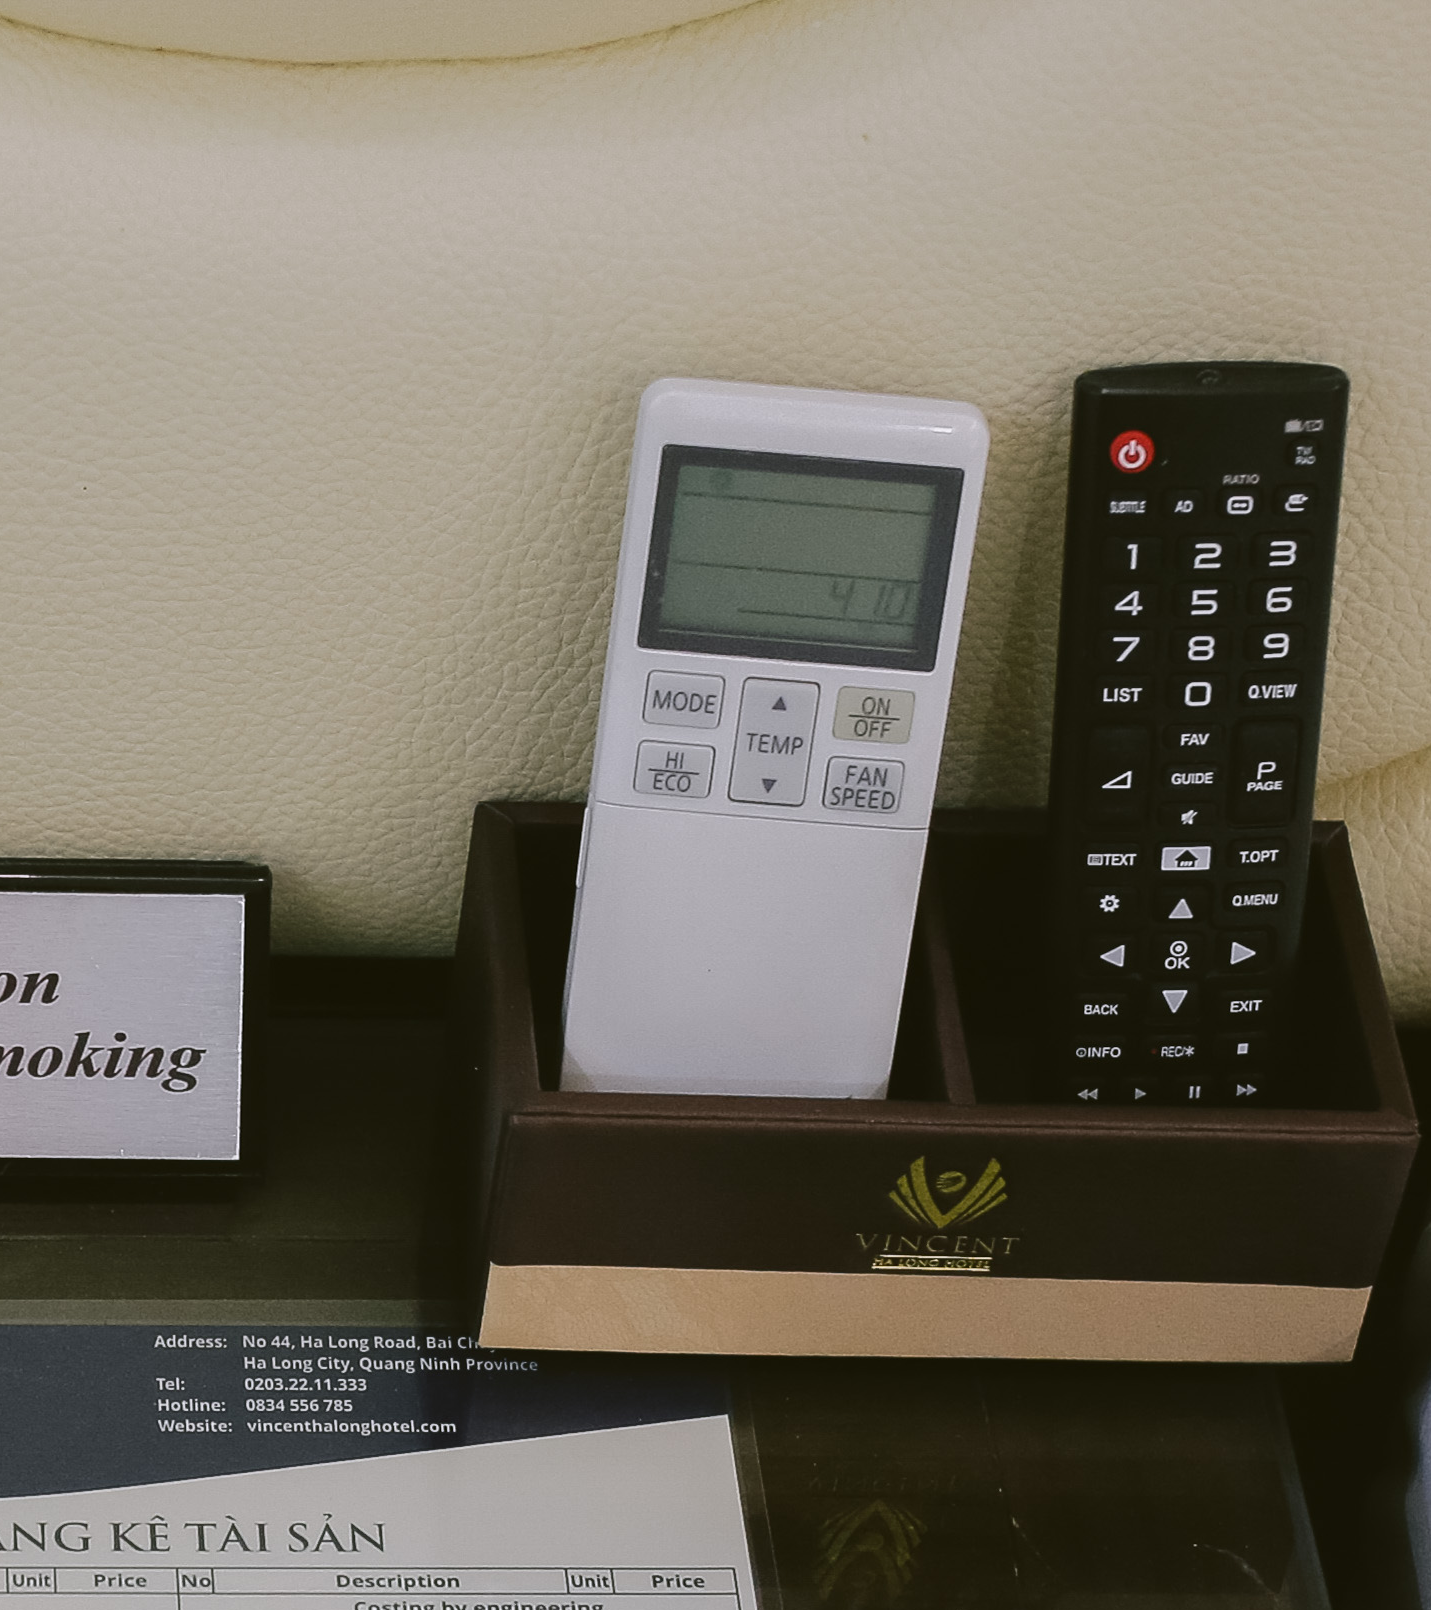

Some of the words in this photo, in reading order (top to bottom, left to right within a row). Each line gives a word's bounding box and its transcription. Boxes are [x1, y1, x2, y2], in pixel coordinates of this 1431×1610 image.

[1222, 474, 1260, 485] RATIO
[1175, 501, 1193, 513] AD
[1127, 544, 1139, 569] 1
[1193, 543, 1222, 569] 2
[1269, 541, 1297, 566] 3
[1114, 591, 1143, 615] 4
[1191, 589, 1218, 615] 5
[1266, 587, 1293, 612] 6
[1113, 636, 1140, 662] 7
[1188, 636, 1215, 661] 8
[1263, 633, 1289, 659] 9
[1103, 688, 1143, 702] LIST
[1184, 682, 1212, 706] 0
[1248, 684, 1297, 699] Q.VIEW
[652, 690, 717, 715] MODE
[862, 697, 891, 716] ON
[854, 720, 892, 738] OFF
[746, 733, 804, 755] TEMP
[1180, 733, 1209, 746] FAV
[665, 751, 685, 768] HI
[845, 765, 888, 787] FAN
[1171, 773, 1213, 785] GUIDE
[1257, 762, 1276, 779] P
[653, 773, 691, 793] ECO
[1246, 781, 1282, 791] PAGE
[830, 787, 895, 811] SPEED
[1104, 853, 1137, 866] TEXT
[1240, 850, 1279, 863] T.OPT
[1232, 894, 1278, 907] Q.MENU
[1164, 958, 1190, 969] OK
[1083, 1004, 1118, 1015] BACK
[1230, 1000, 1262, 1012] EXIT
[1087, 1047, 1121, 1058] INFO
[856, 1233, 1020, 1254] VINCENT
[154, 1334, 228, 1349] Address:
[243, 1336, 267, 1348] No
[270, 1335, 295, 1350] 44,
[300, 1335, 323, 1349] Ha
[328, 1335, 370, 1353] Long
[374, 1335, 420, 1350] Road,
[426, 1336, 452, 1349] Bai
[244, 1357, 265, 1370] Ha
[271, 1357, 313, 1374] Long
[317, 1356, 354, 1374] City,
[359, 1357, 415, 1374] Quang
[420, 1357, 460, 1371] Ninh
[466, 1358, 538, 1371] Province
[156, 1378, 185, 1391] Tel:
[245, 1378, 367, 1392] 0203.22.11.333
[157, 1399, 226, 1412] Hotline:
[245, 1399, 285, 1412] 0834
[290, 1399, 320, 1412] 556
[322, 1399, 353, 1412] 785
[157, 1419, 233, 1433] Website:
[246, 1419, 457, 1437] vincenthalonghotel.com
[111, 1515, 170, 1552] KÊ
[184, 1515, 267, 1552] TÀI
[288, 1513, 384, 1553] SẢN
[12, 1574, 51, 1588] Unit
[94, 1574, 147, 1588] Price
[181, 1574, 211, 1588] No
[336, 1574, 460, 1591] Description
[571, 1574, 610, 1588] Unit
[651, 1574, 705, 1588] Price
